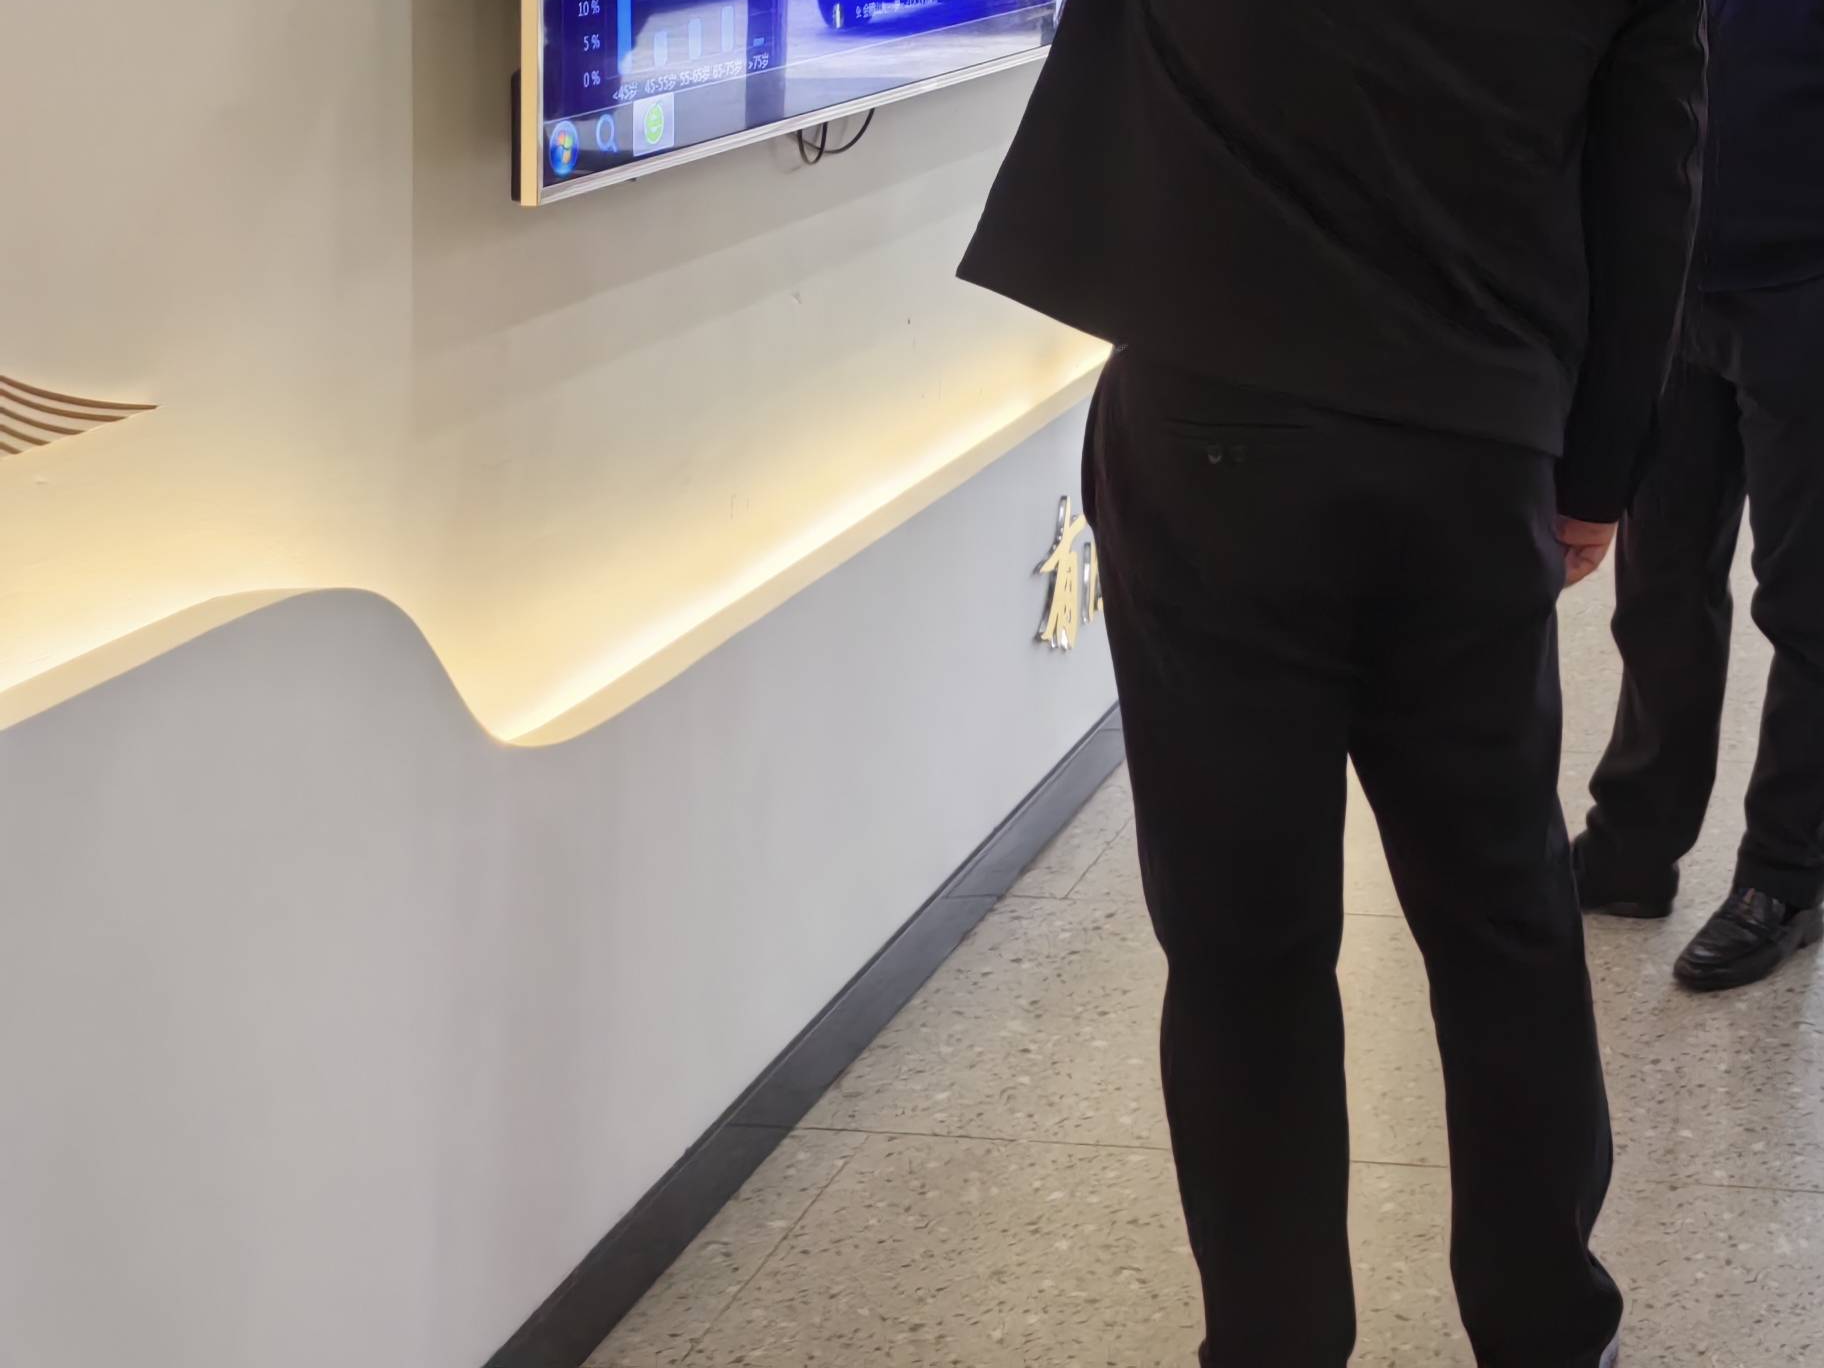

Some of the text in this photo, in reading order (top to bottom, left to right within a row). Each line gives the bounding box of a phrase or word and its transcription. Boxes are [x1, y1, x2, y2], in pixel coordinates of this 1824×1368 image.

[578, 0, 600, 17] 10 %
[583, 35, 600, 51] 5 %
[583, 71, 600, 87] 0 %
